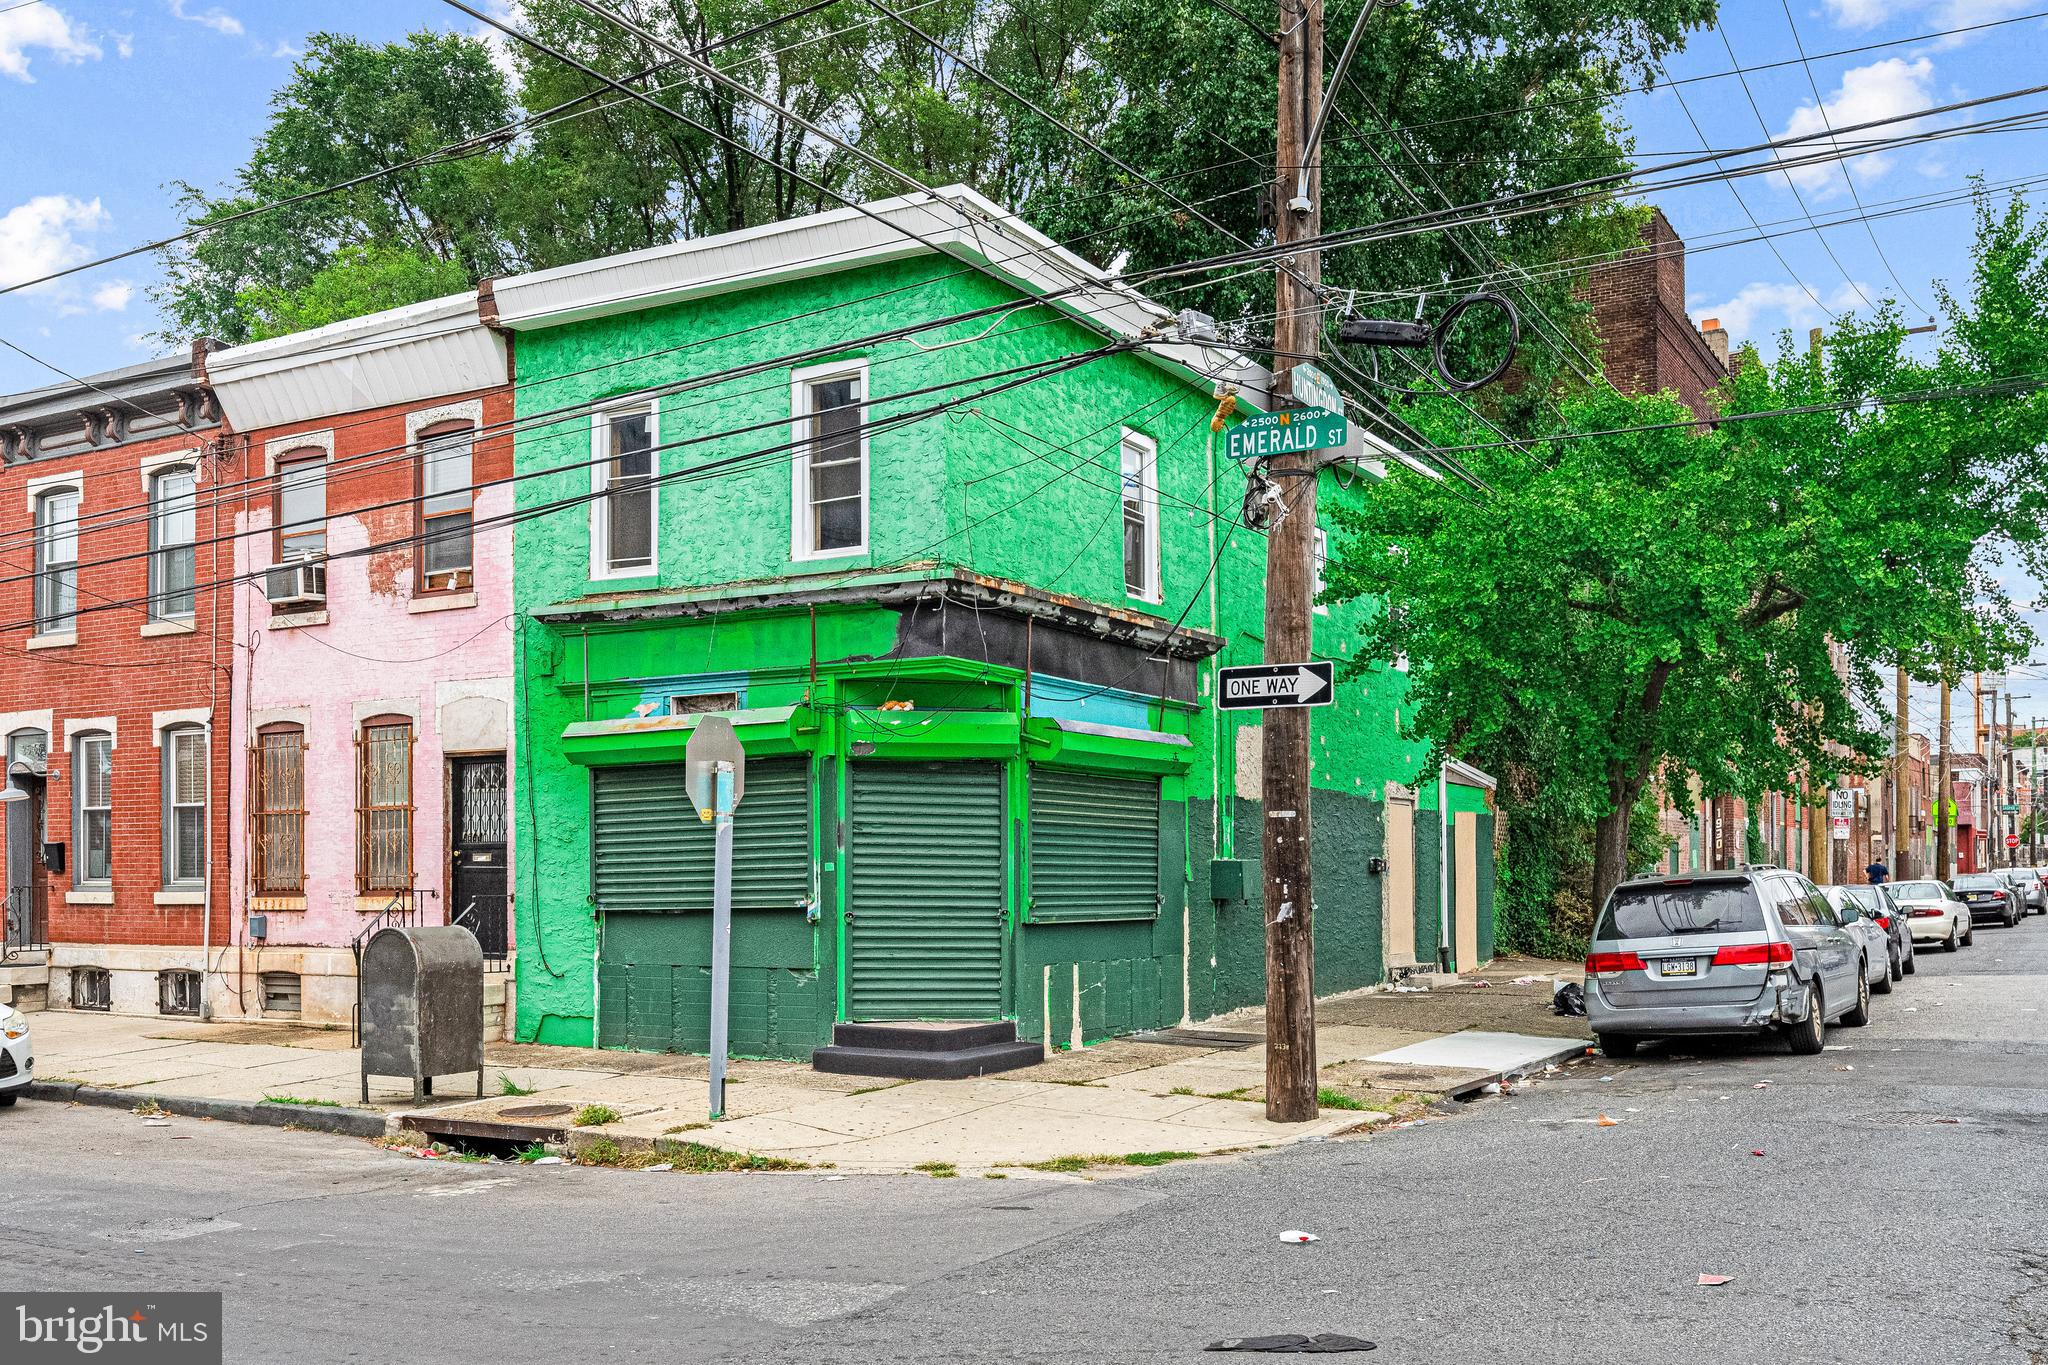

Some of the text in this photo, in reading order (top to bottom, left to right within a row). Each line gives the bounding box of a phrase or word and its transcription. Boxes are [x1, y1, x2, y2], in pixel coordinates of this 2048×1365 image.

[1294, 371, 1337, 412] HUNTINGDON
[1251, 410, 1321, 428] 2500 N 2600
[1230, 425, 1343, 457] EMERALD ST
[1231, 677, 1299, 696] ONE WAY
[1836, 791, 1848, 800] NO
